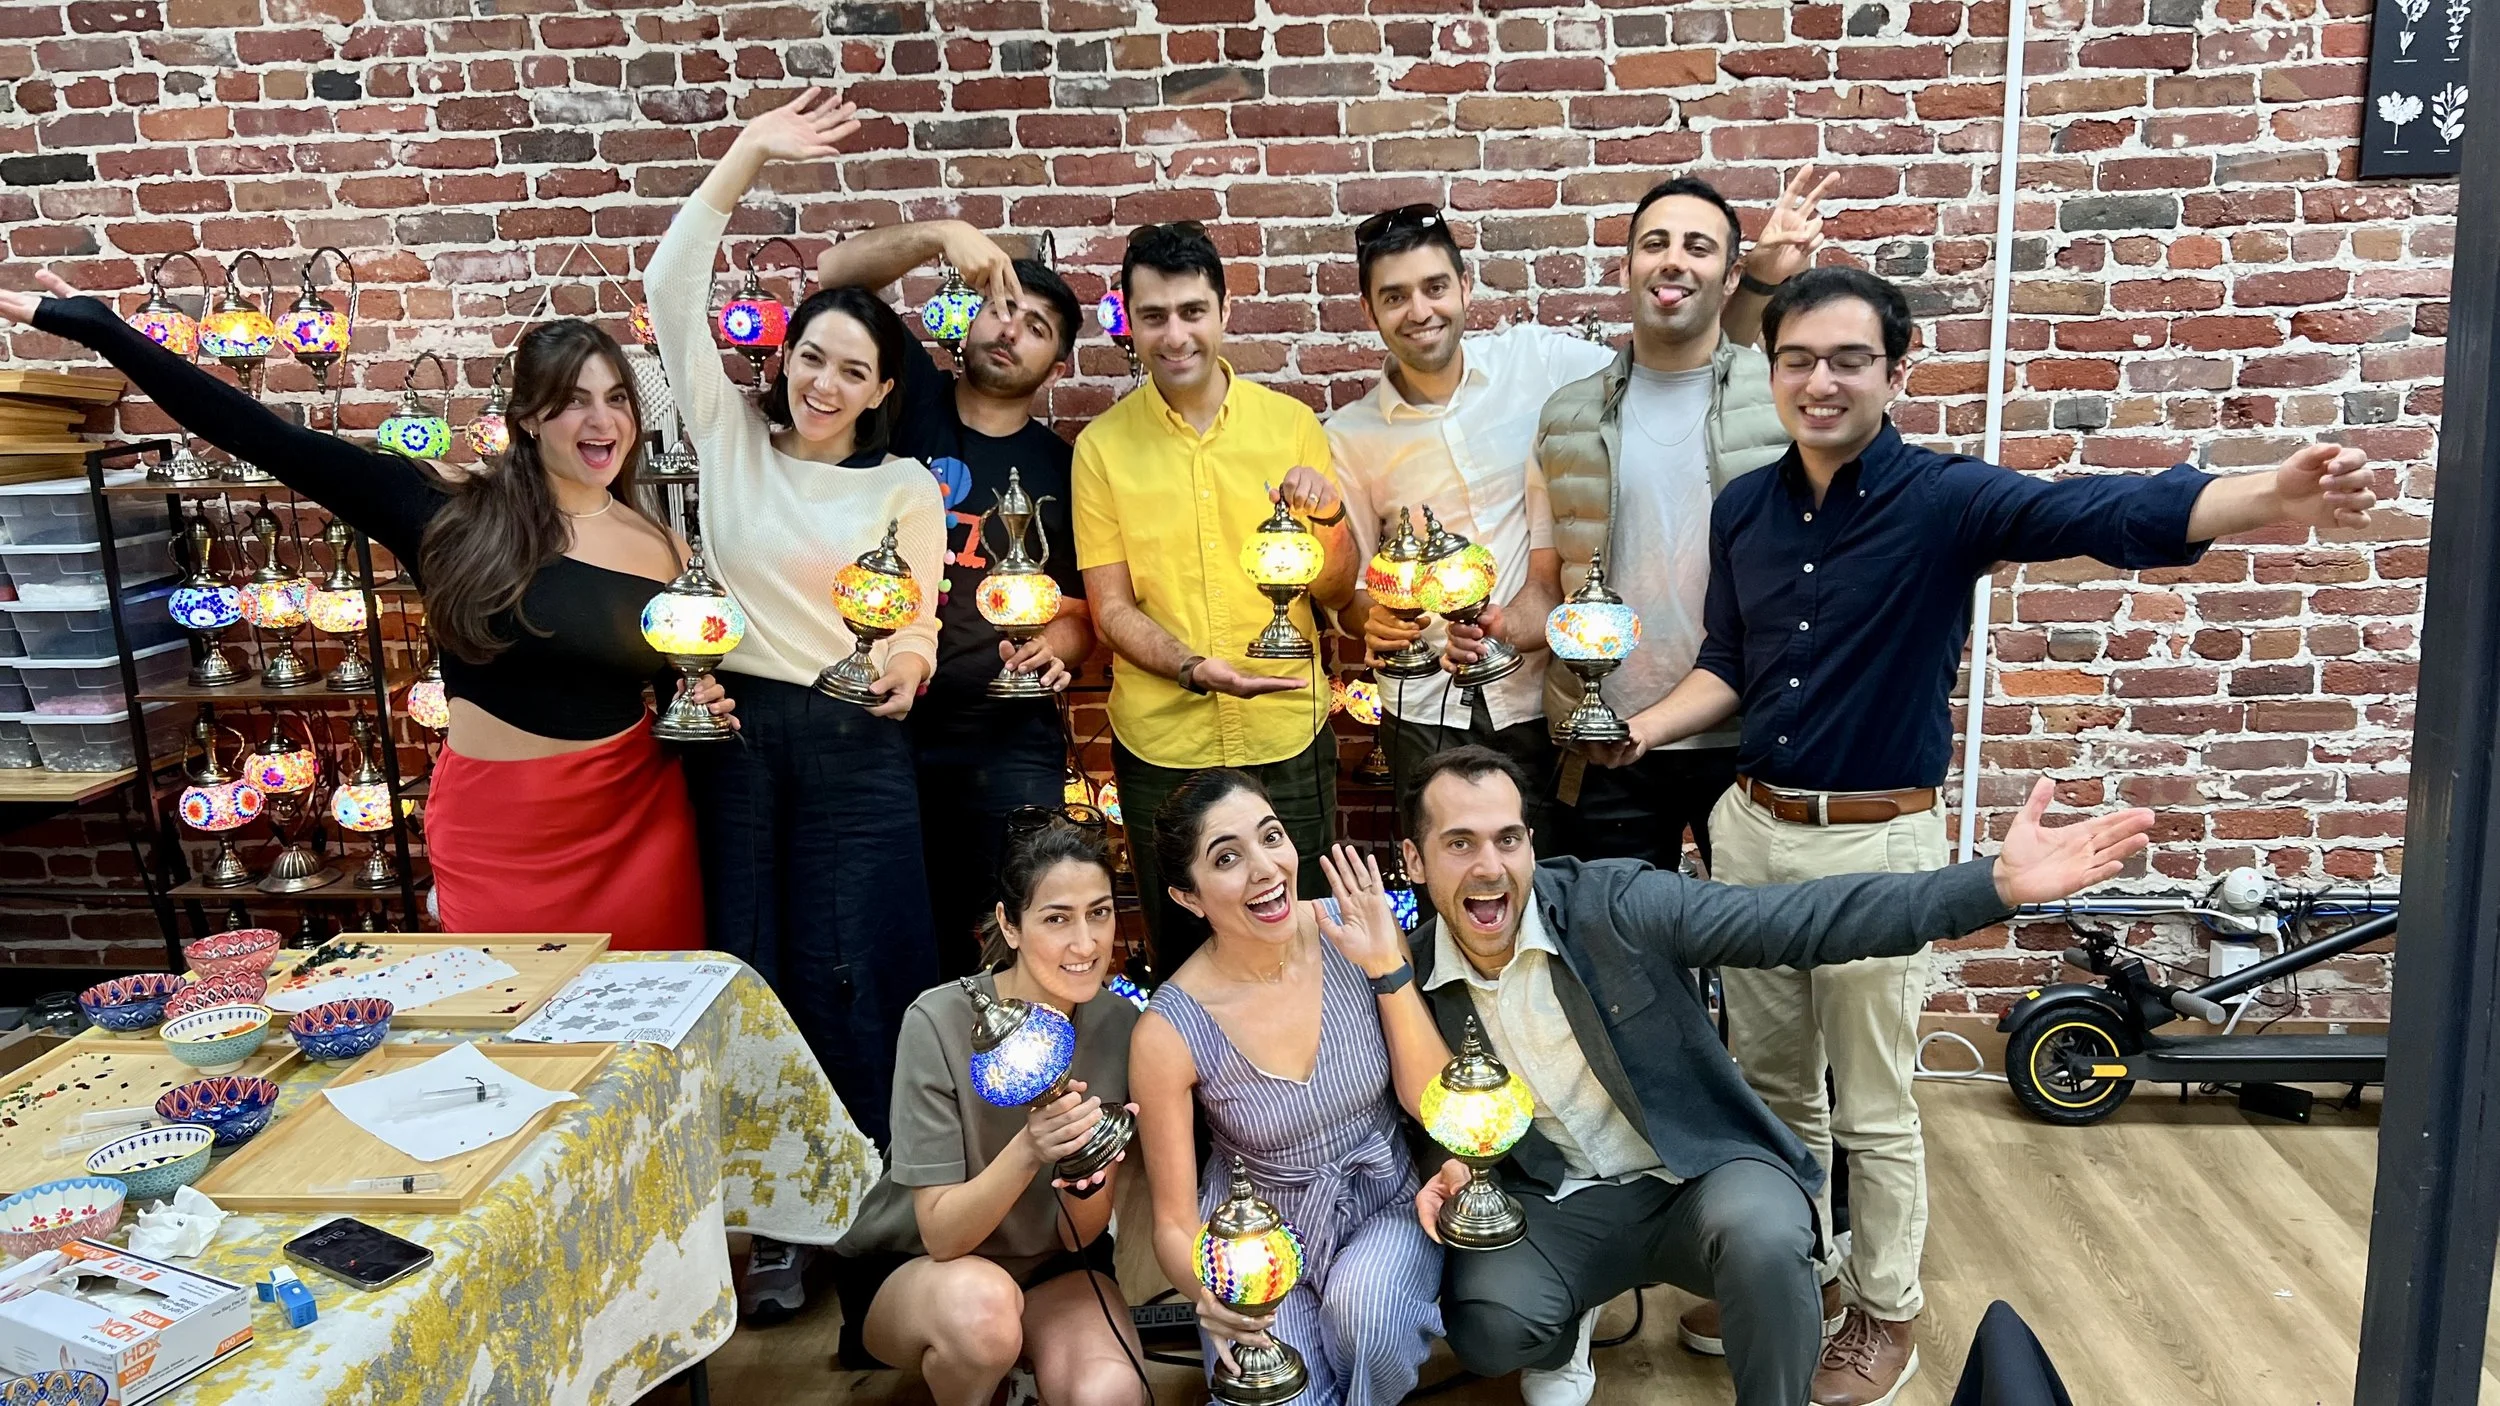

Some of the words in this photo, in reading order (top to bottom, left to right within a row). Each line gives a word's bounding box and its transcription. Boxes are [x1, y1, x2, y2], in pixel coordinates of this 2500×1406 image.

[133, 1311, 165, 1327] VINYL
[88, 1317, 147, 1343] HDX
[122, 1335, 162, 1366] HDX
[220, 1337, 236, 1351] 100
[125, 1363, 146, 1378] VINYL
